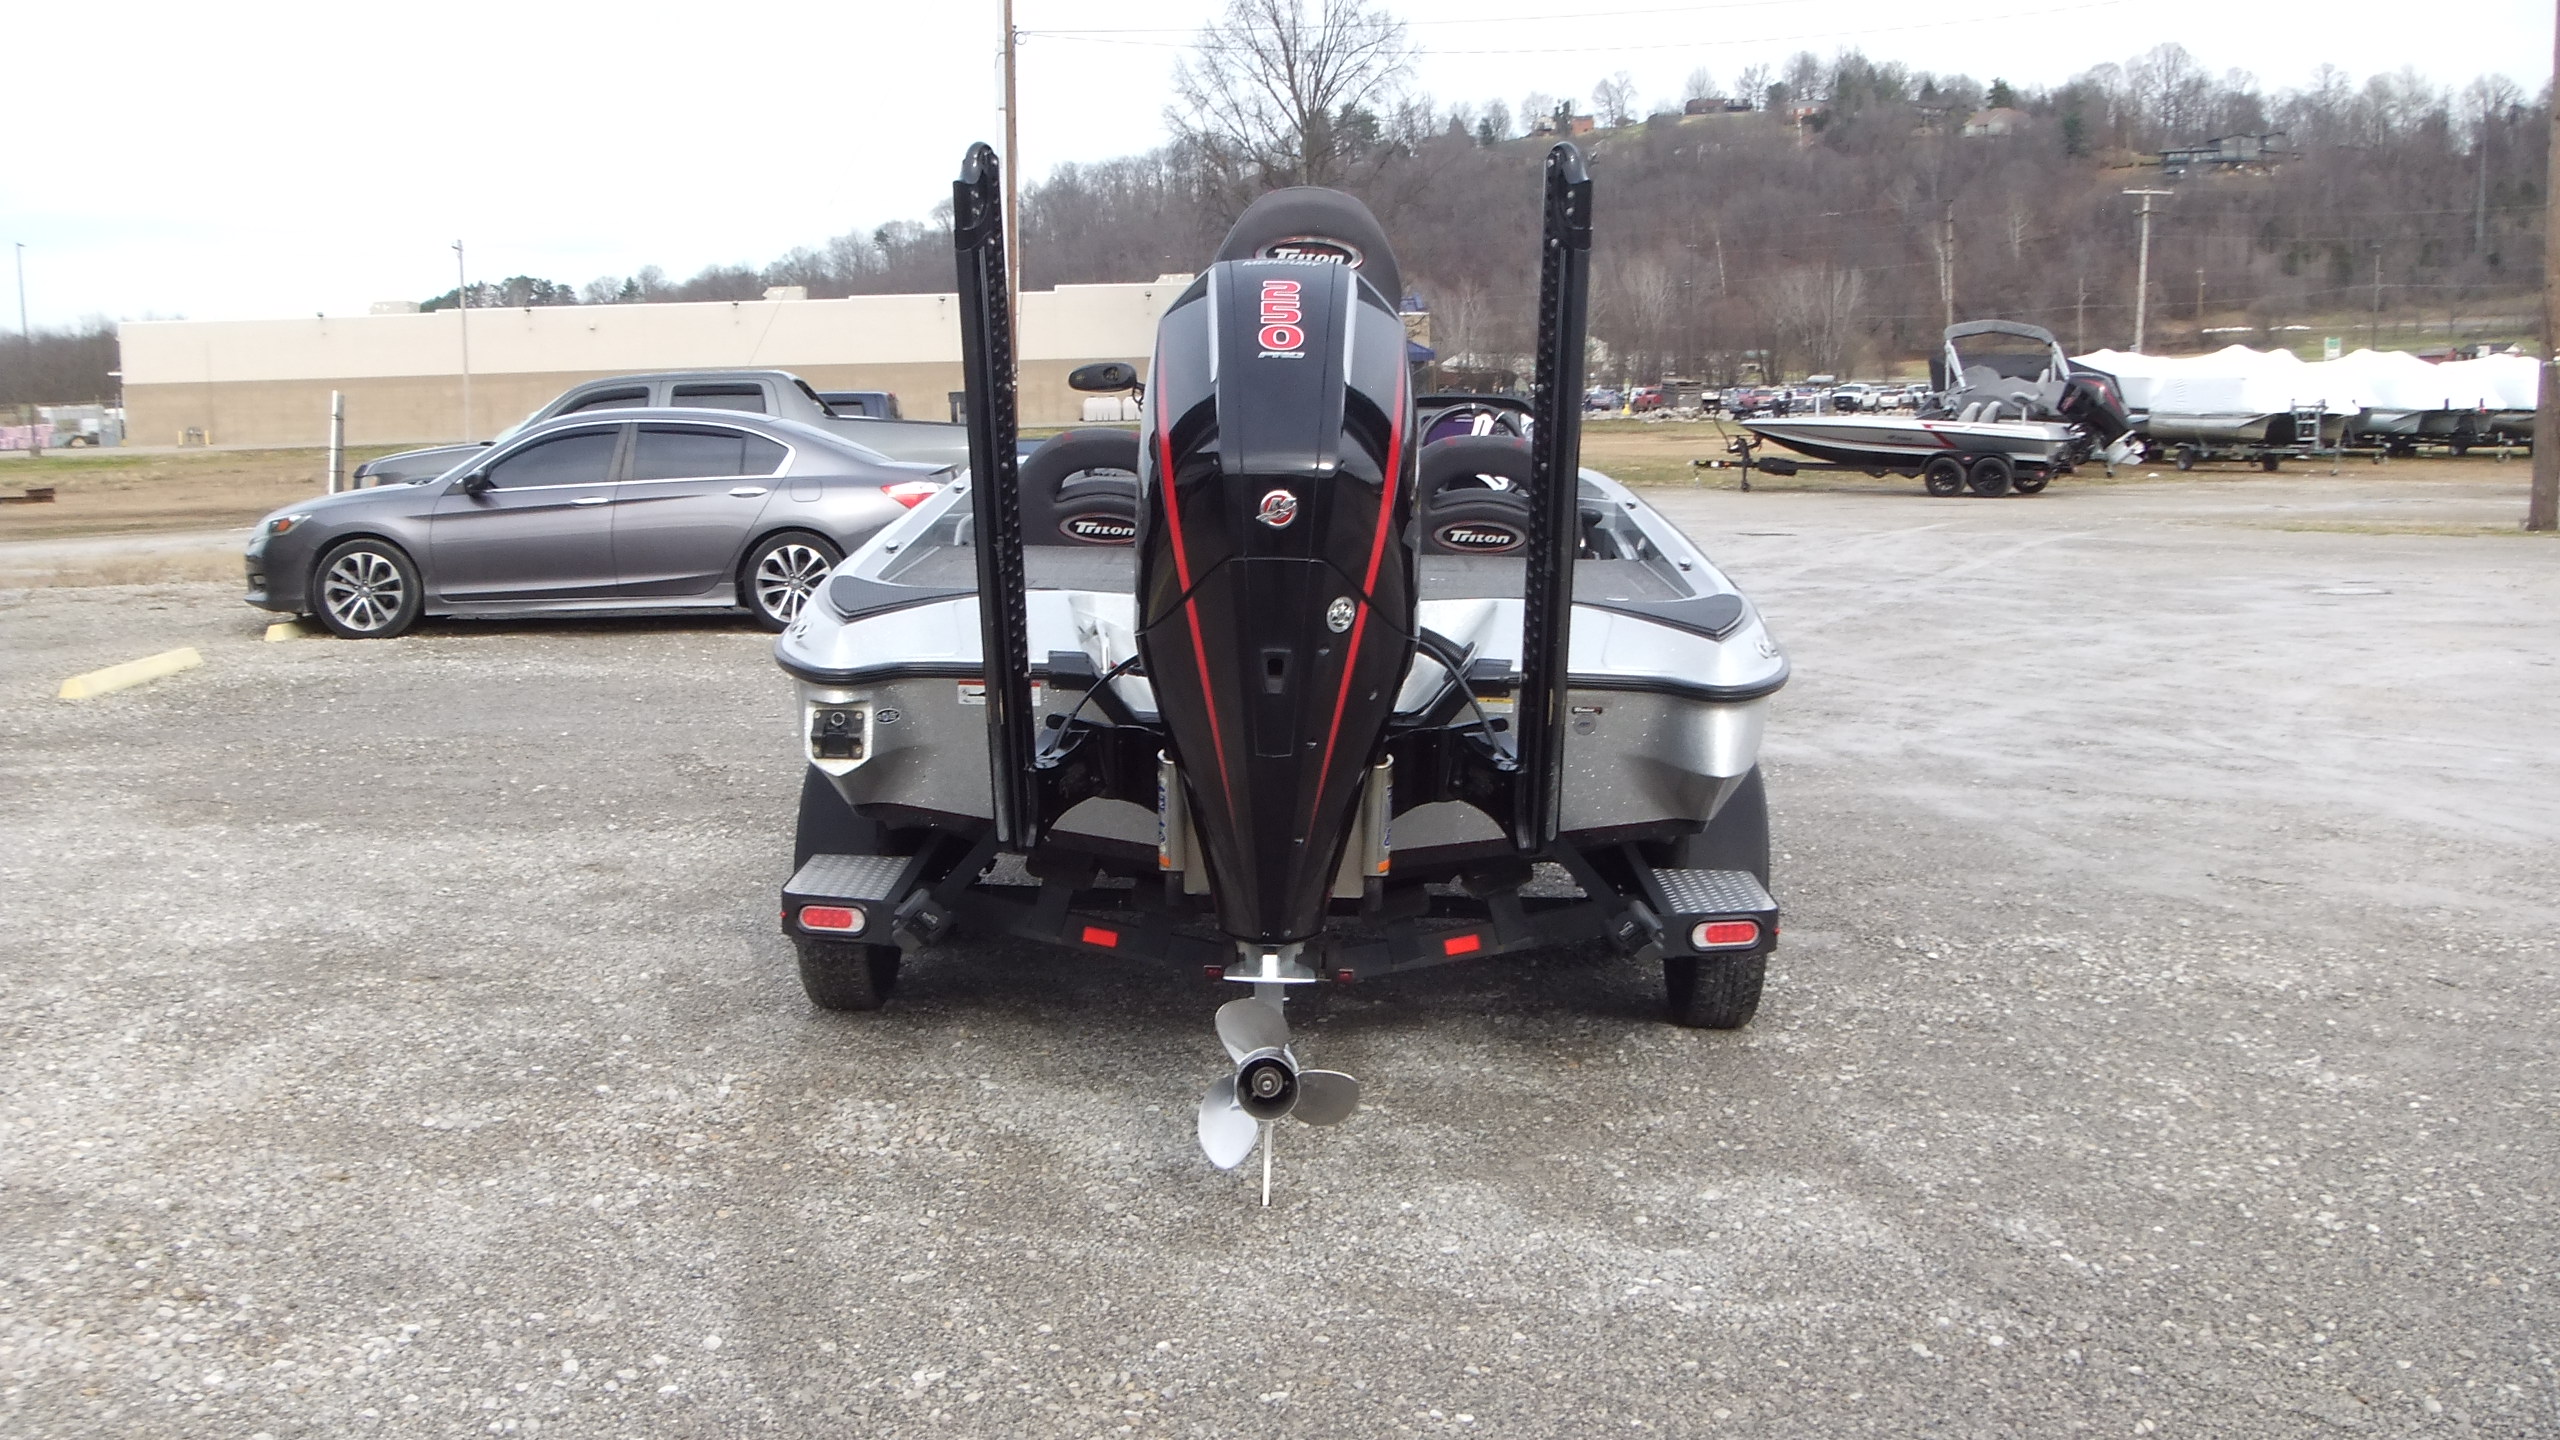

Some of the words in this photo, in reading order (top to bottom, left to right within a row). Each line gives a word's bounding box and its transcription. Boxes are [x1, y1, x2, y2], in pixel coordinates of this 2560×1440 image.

[1258, 280, 1304, 351] 250
[1075, 521, 1136, 536] Triton
[1450, 529, 1510, 544] Triton
